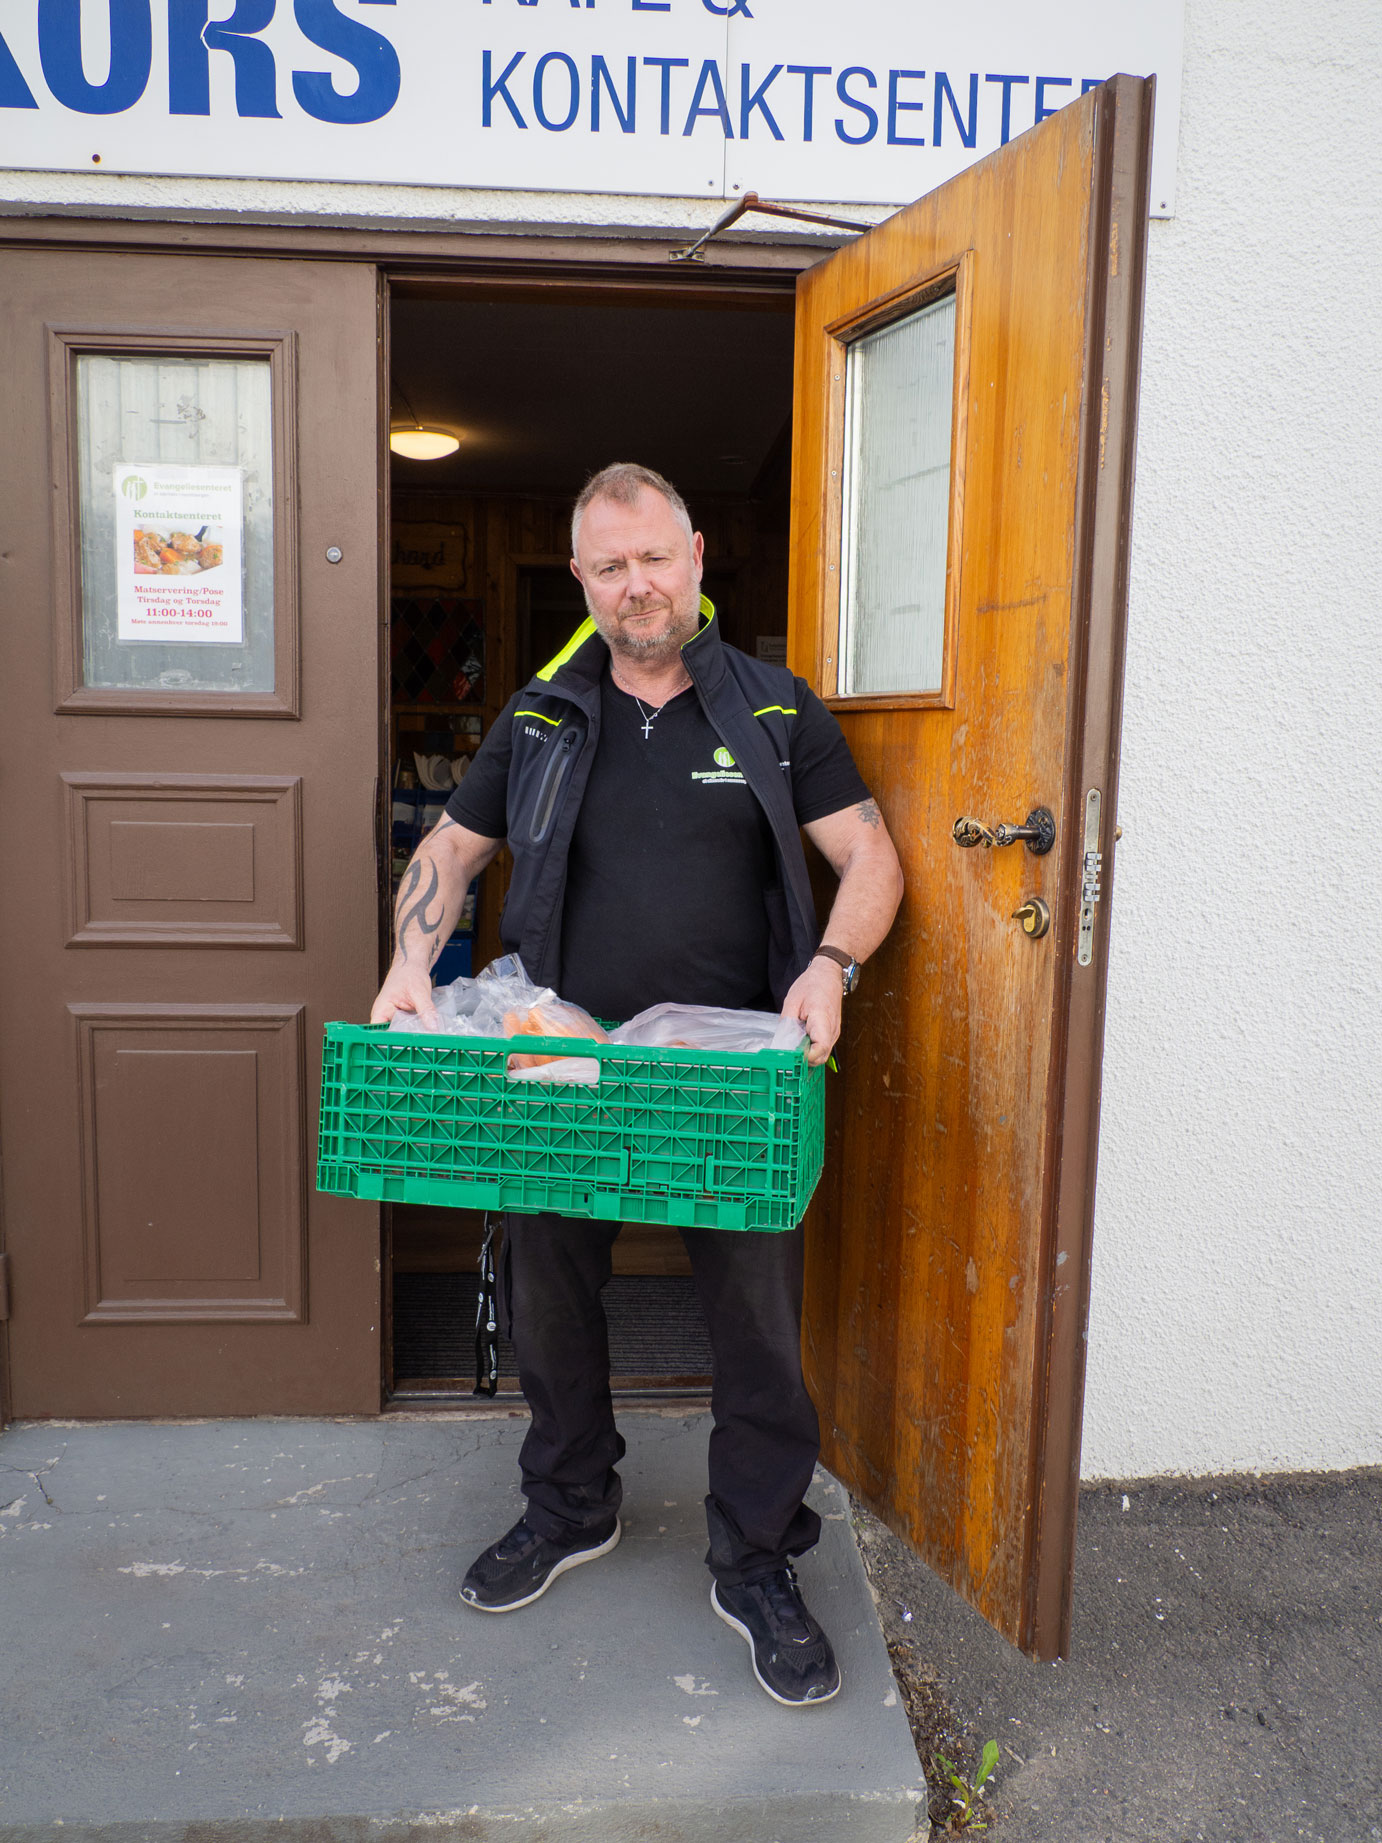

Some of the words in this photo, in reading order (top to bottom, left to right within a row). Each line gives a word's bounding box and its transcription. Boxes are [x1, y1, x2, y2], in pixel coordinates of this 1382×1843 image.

[0, 0, 401, 125] ORS
[482, 50, 1106, 149] KONTAKTSENTE
[134, 509, 222, 520] Kontaktsenteret
[134, 586, 224, 596] Matservering/Pose
[137, 596, 171, 606] Tirsdag
[186, 597, 221, 607] Torsdag
[146, 608, 213, 618] 11:00-14:00
